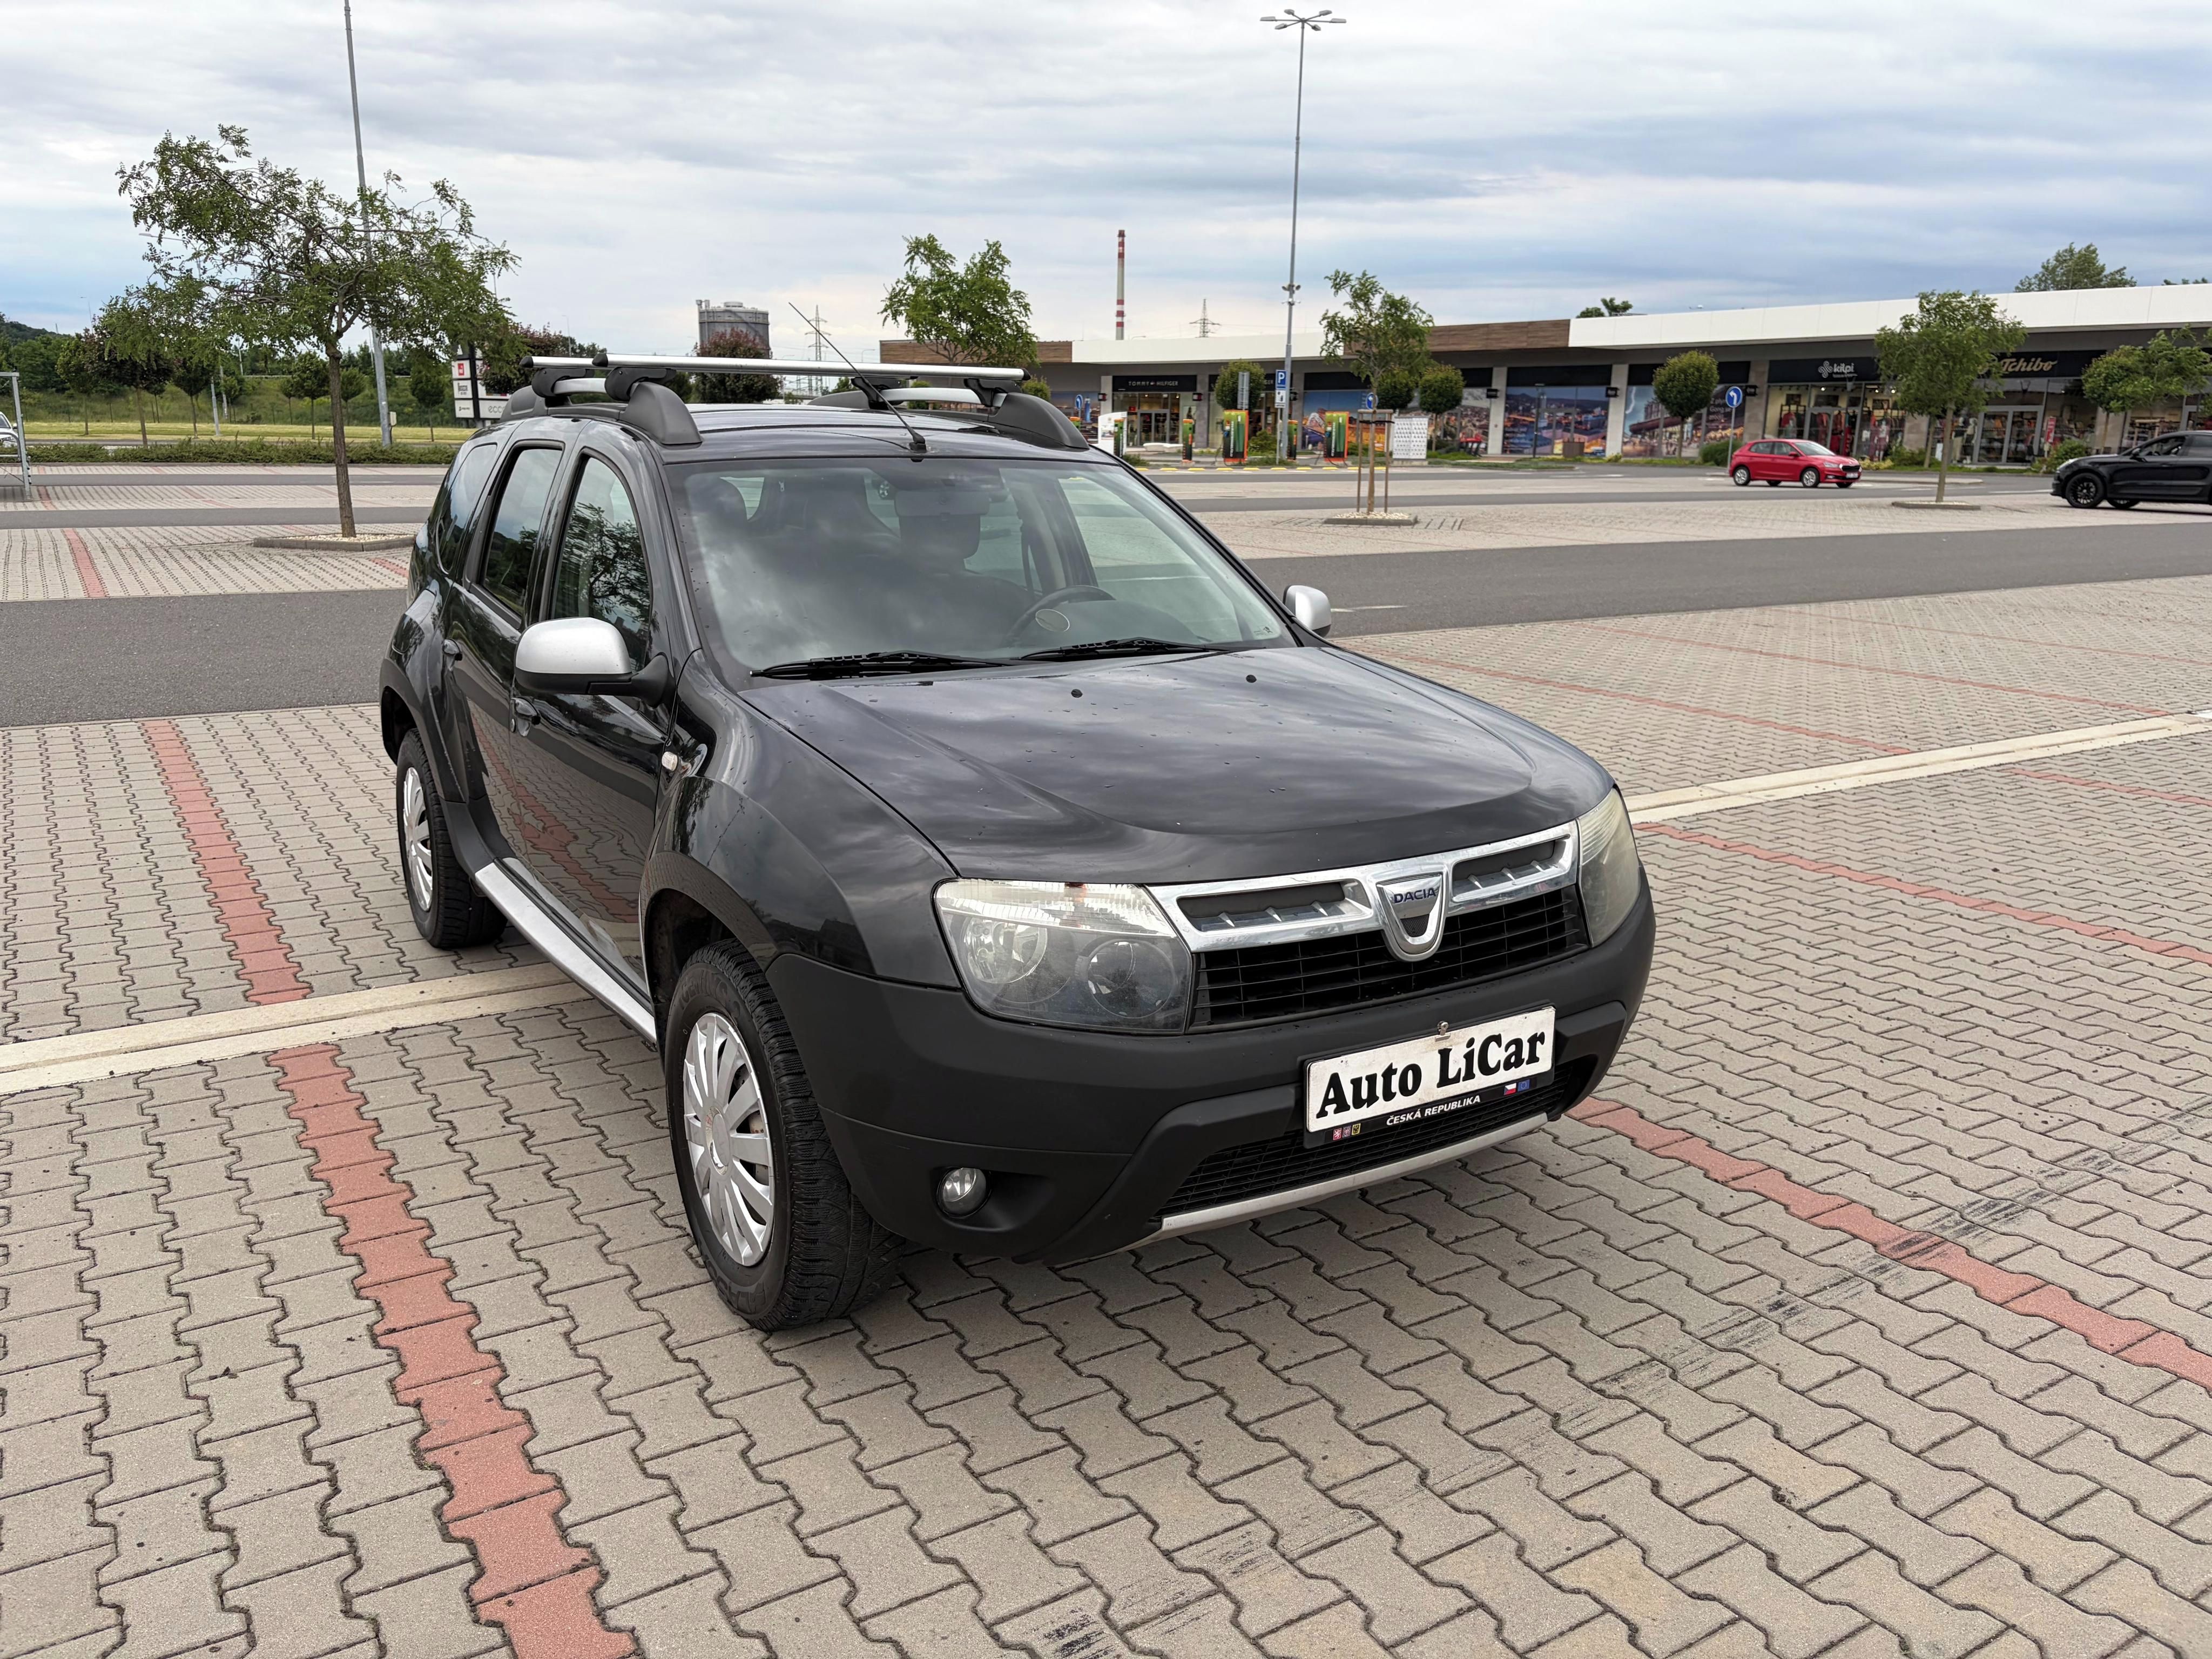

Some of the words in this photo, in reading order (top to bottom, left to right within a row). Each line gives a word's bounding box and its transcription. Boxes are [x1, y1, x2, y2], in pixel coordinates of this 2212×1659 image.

[1833, 363, 1854, 374] kilpi
[2000, 357, 2058, 373] Tchibo
[1278, 372, 1285, 383] P
[1393, 888, 1436, 903] DACIA
[1316, 1063, 1422, 1119] Auto
[1437, 1031, 1545, 1088] LiCar
[1386, 1109, 1422, 1126] ČESKÁ
[1425, 1095, 1481, 1116] REPUBLIKA
